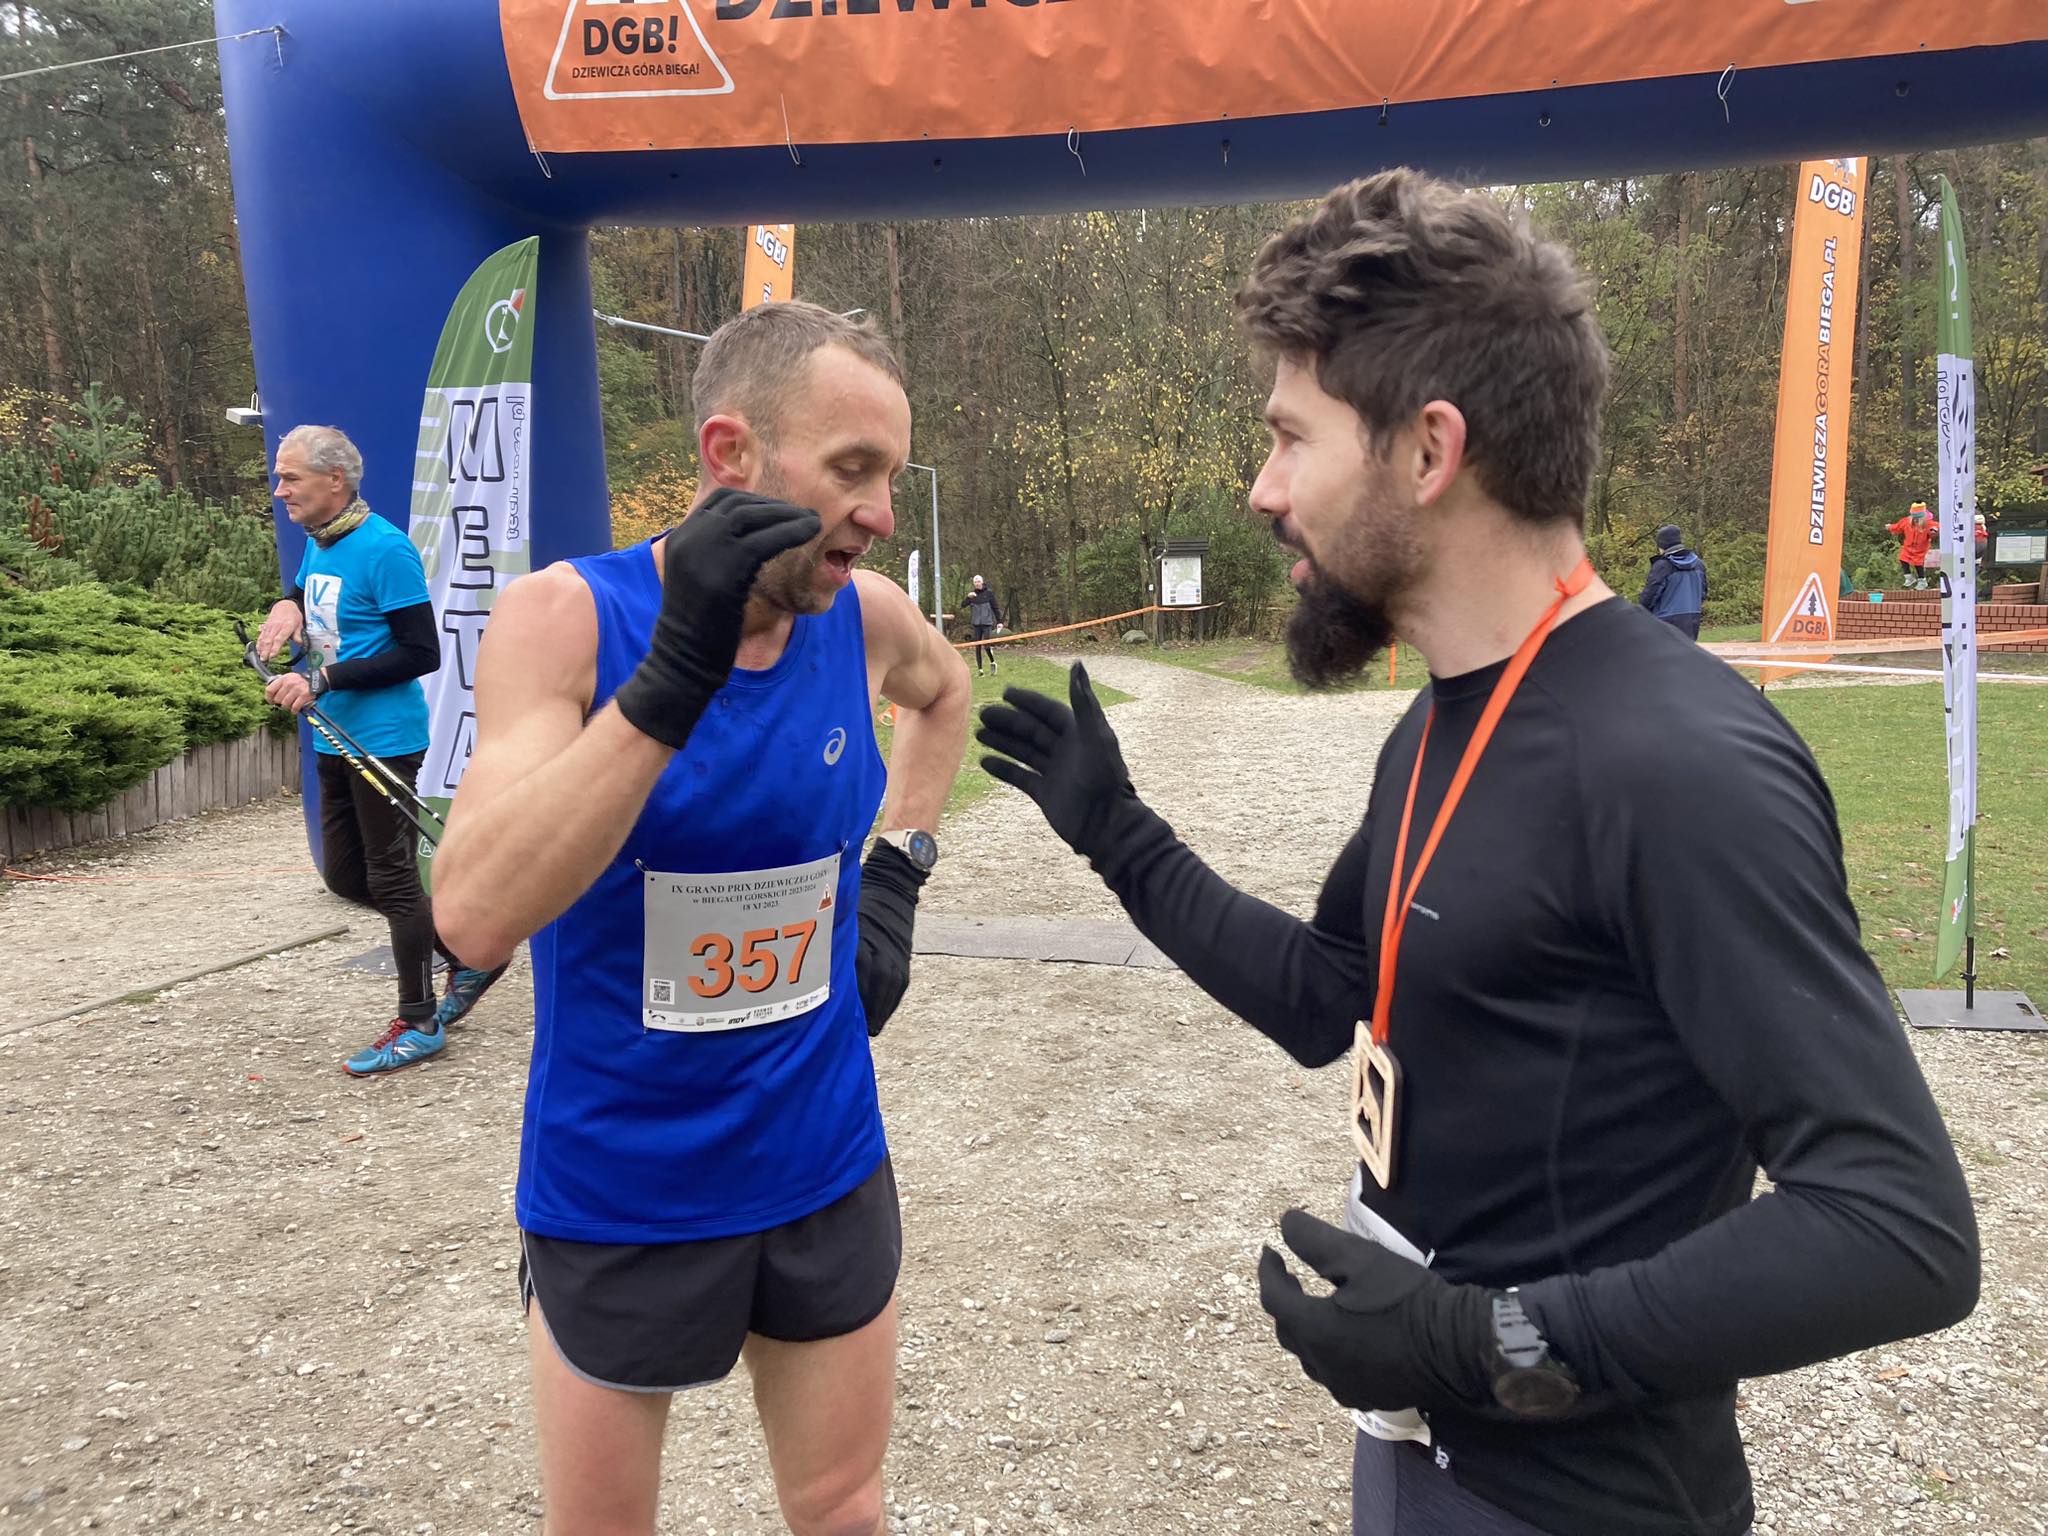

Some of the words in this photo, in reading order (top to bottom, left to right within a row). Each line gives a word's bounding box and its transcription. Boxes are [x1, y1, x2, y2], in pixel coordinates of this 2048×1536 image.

[583, 16, 678, 56] DGB!
[572, 65, 630, 79] DZIEWICZA
[632, 62, 663, 77] GÓRA
[666, 63, 699, 76] BIEGA!
[1809, 173, 1856, 220] DGB!
[1809, 236, 1838, 546] DZIEWICZAGORABIEGA.PL
[1792, 619, 1827, 636] DGB!
[671, 884, 683, 894] IX
[686, 884, 725, 895] GRAND
[727, 882, 752, 894] PRIX
[753, 874, 809, 892] DZIEWICZEJ
[701, 895, 743, 905] BIEGACH
[688, 919, 817, 998] 357
